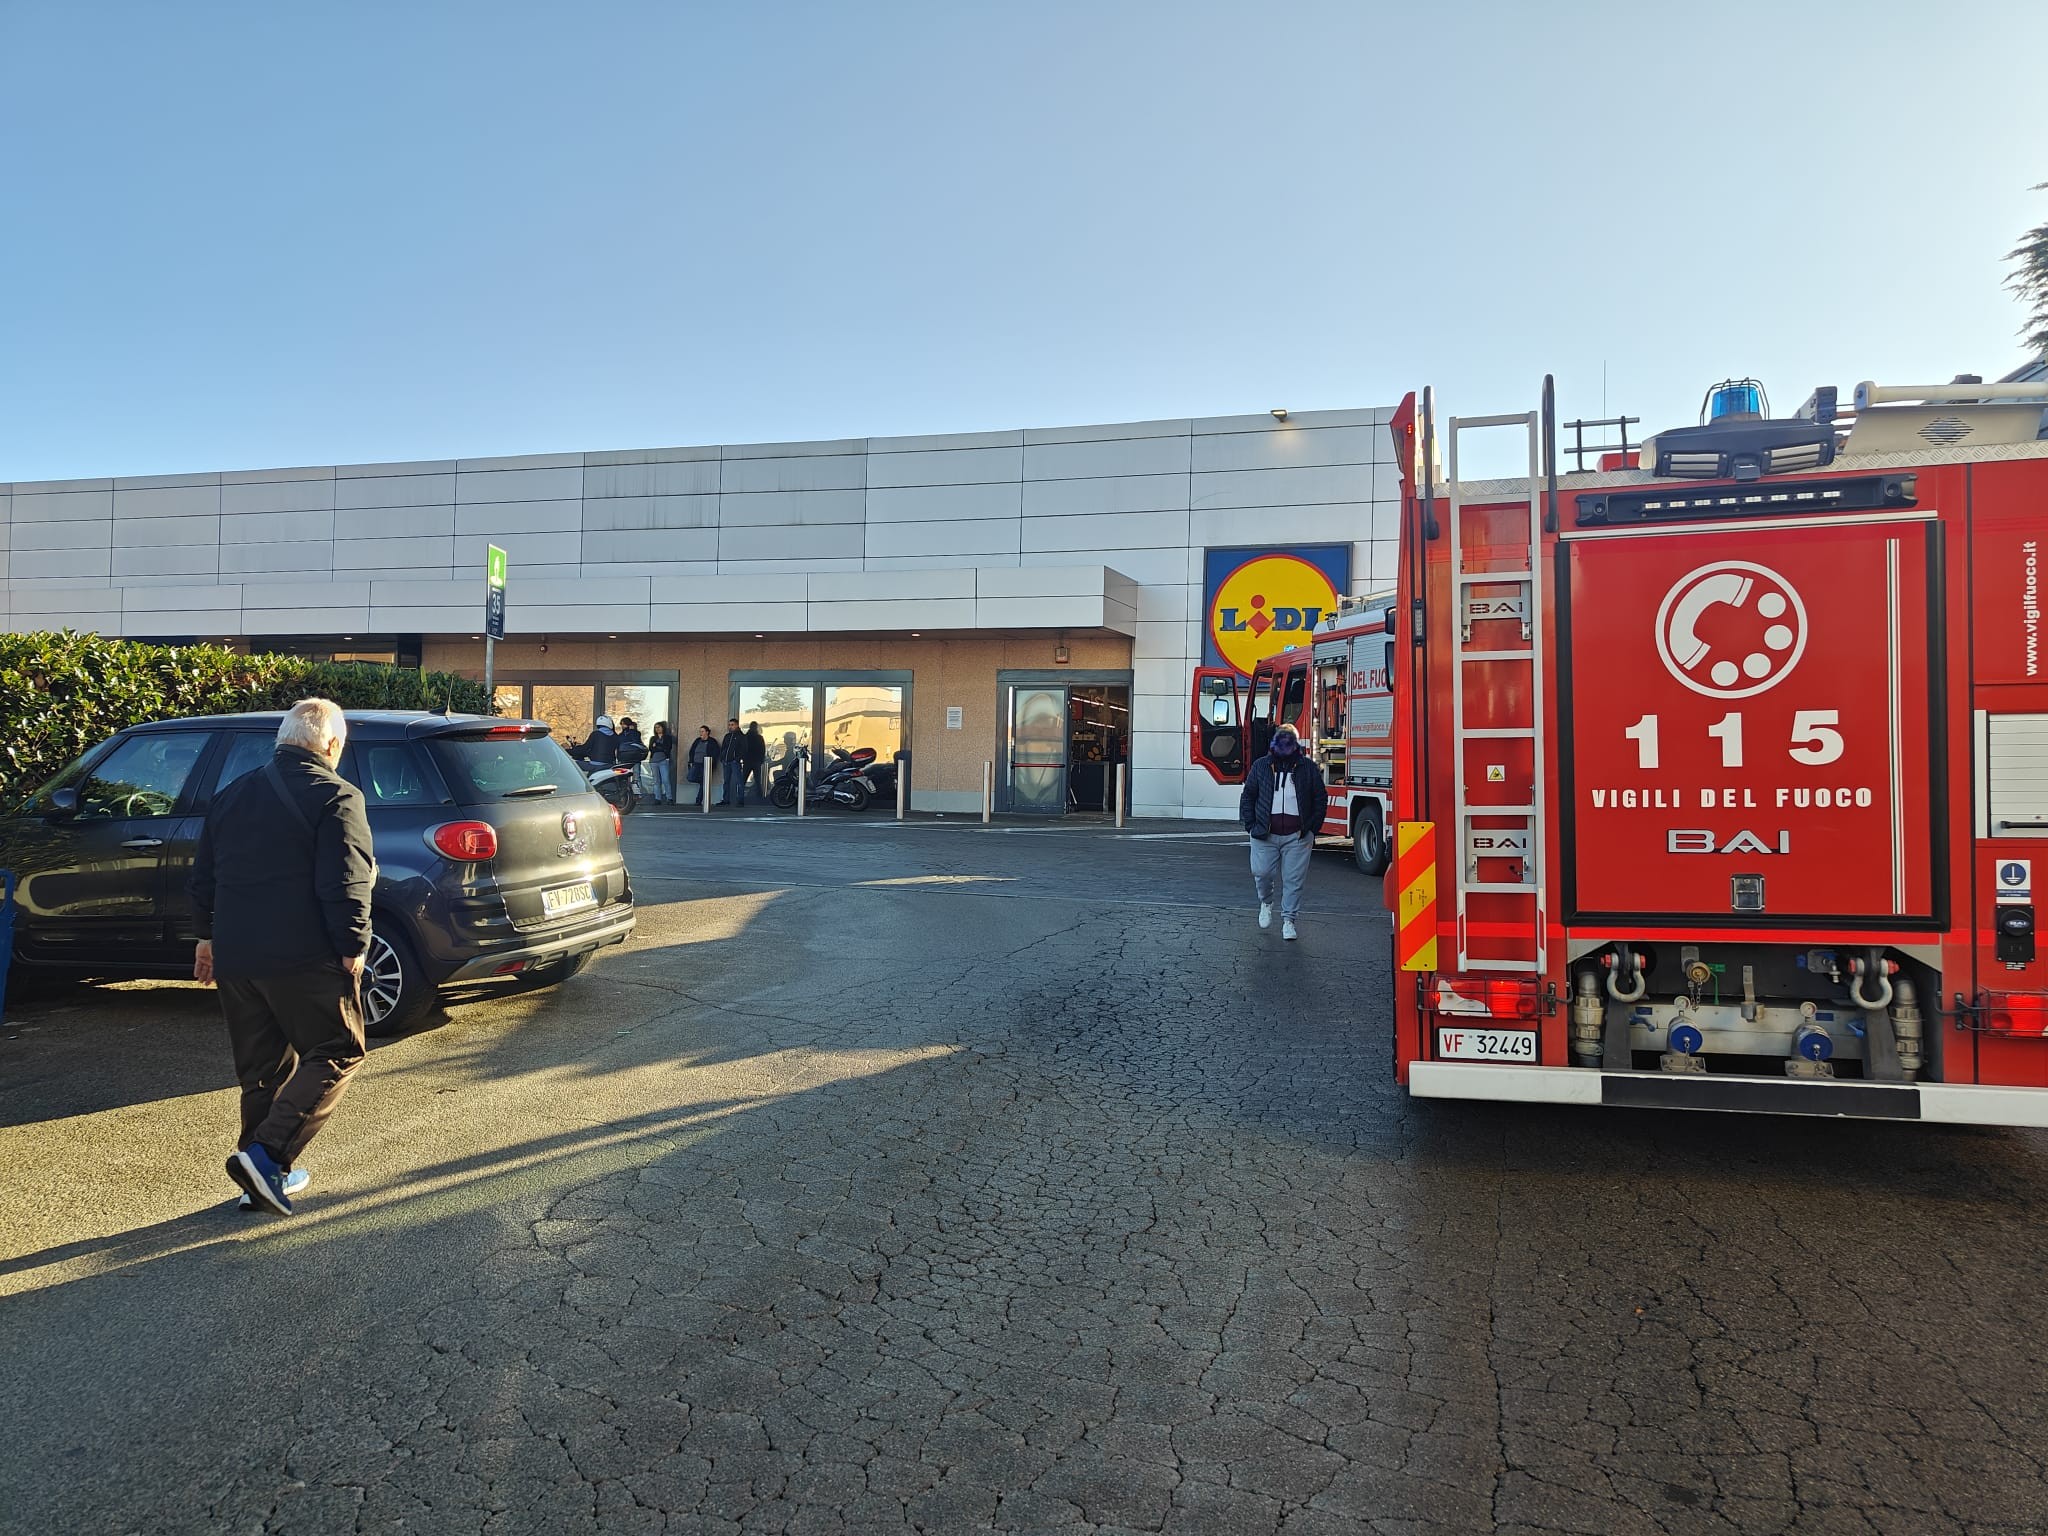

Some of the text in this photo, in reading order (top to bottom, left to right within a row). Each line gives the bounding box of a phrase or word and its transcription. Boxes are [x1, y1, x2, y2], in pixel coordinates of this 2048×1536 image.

[1469, 602, 1523, 614] BAI
[2023, 541, 2040, 676] www.vigilfuoco.it
[1352, 667, 1387, 690] DEL FUO
[1592, 787, 1872, 808] VIGILI DEL FUOCO
[1473, 838, 1527, 848] BAI
[1667, 829, 1790, 854] BAI
[1443, 1034, 1532, 1055] VF 32449
